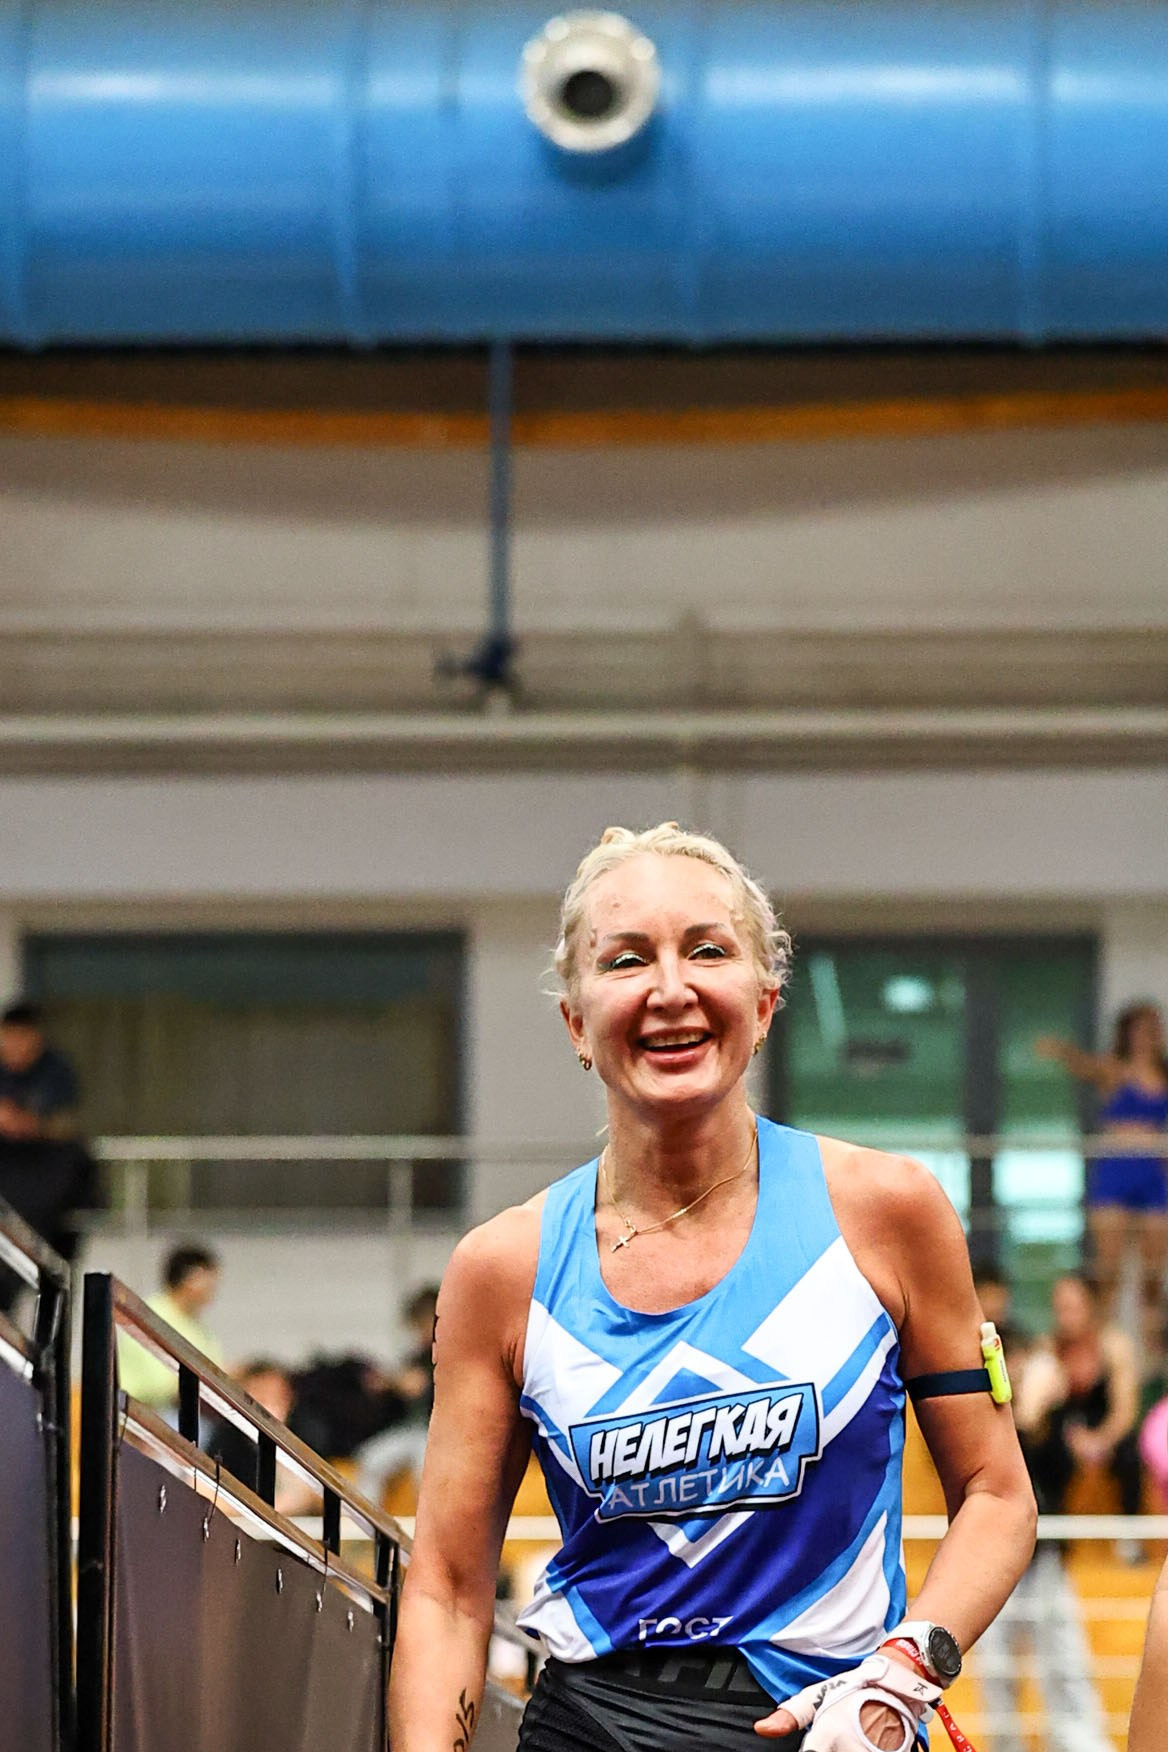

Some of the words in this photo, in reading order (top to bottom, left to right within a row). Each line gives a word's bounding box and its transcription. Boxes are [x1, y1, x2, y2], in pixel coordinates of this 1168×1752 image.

[590, 1392, 804, 1483] НЕЛЕГКАЯ
[609, 1457, 791, 1510] АТЛЕТИКА
[637, 1615, 734, 1641] ГОСТ
